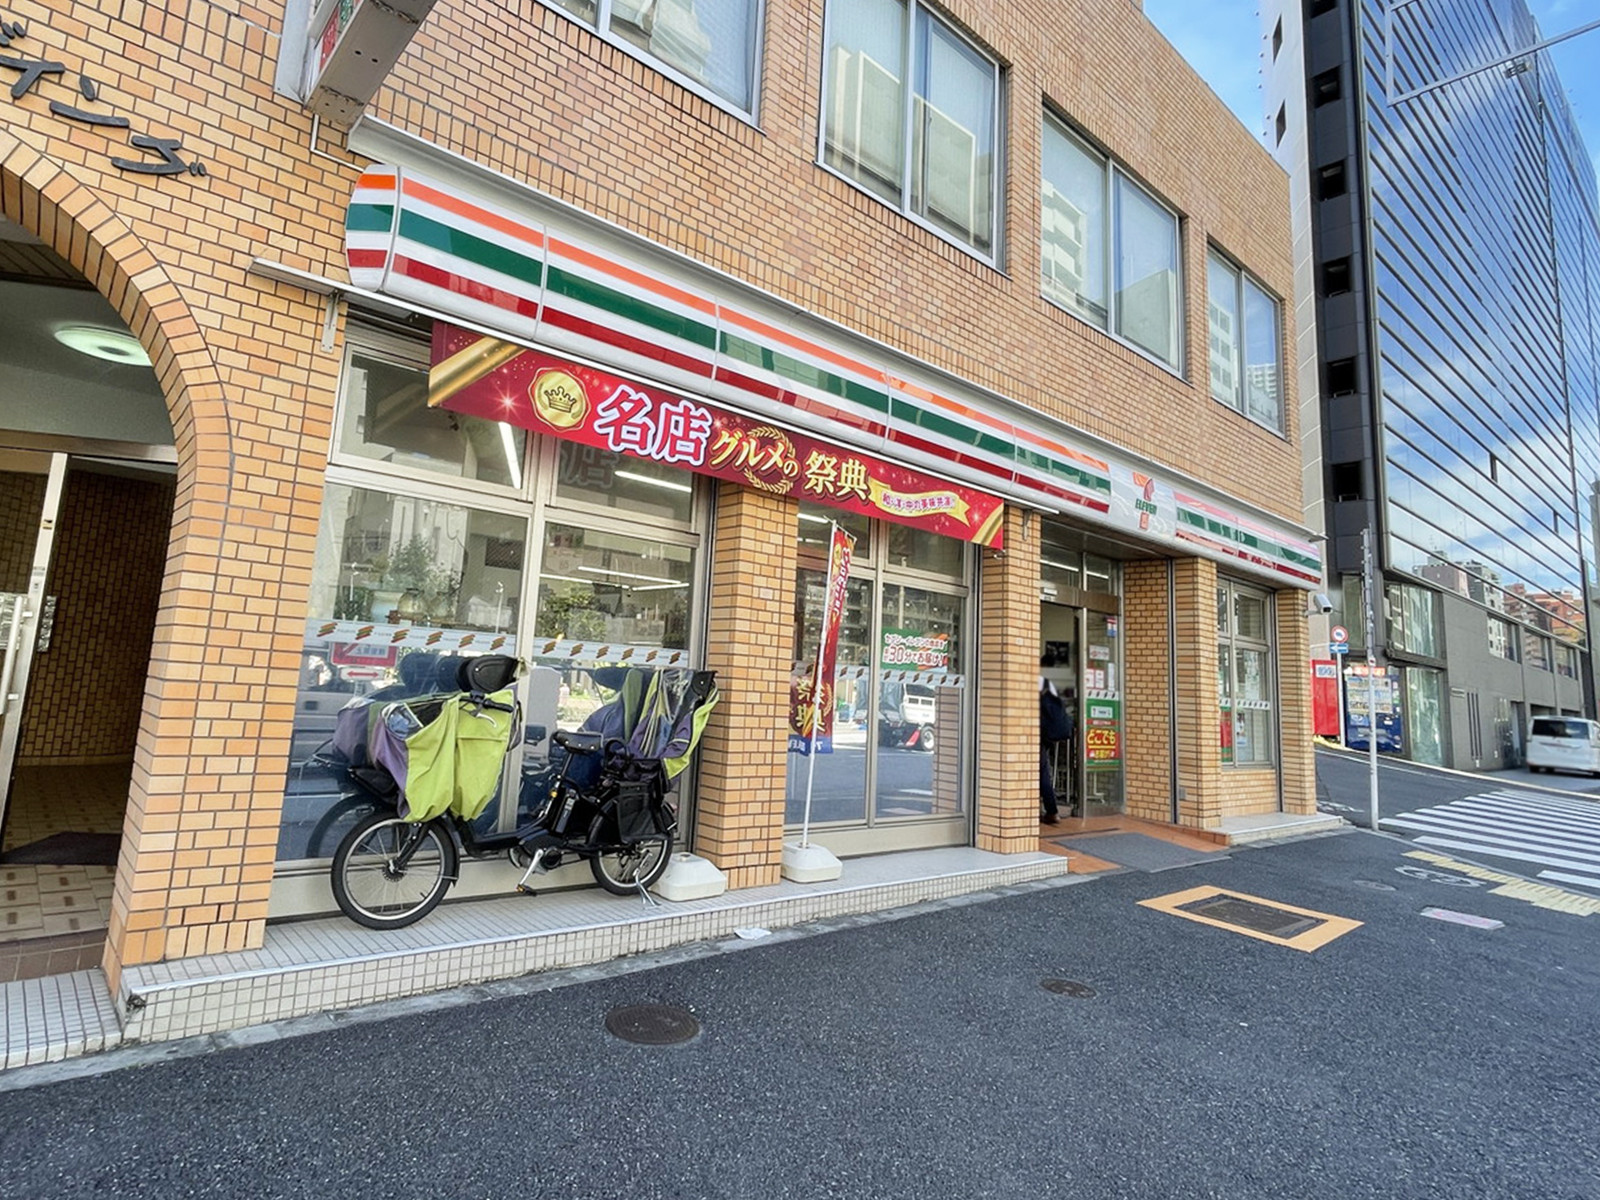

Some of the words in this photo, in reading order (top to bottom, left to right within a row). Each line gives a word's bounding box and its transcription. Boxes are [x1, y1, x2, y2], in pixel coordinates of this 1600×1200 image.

[594, 384, 868, 500] 名店グルメの祭典
